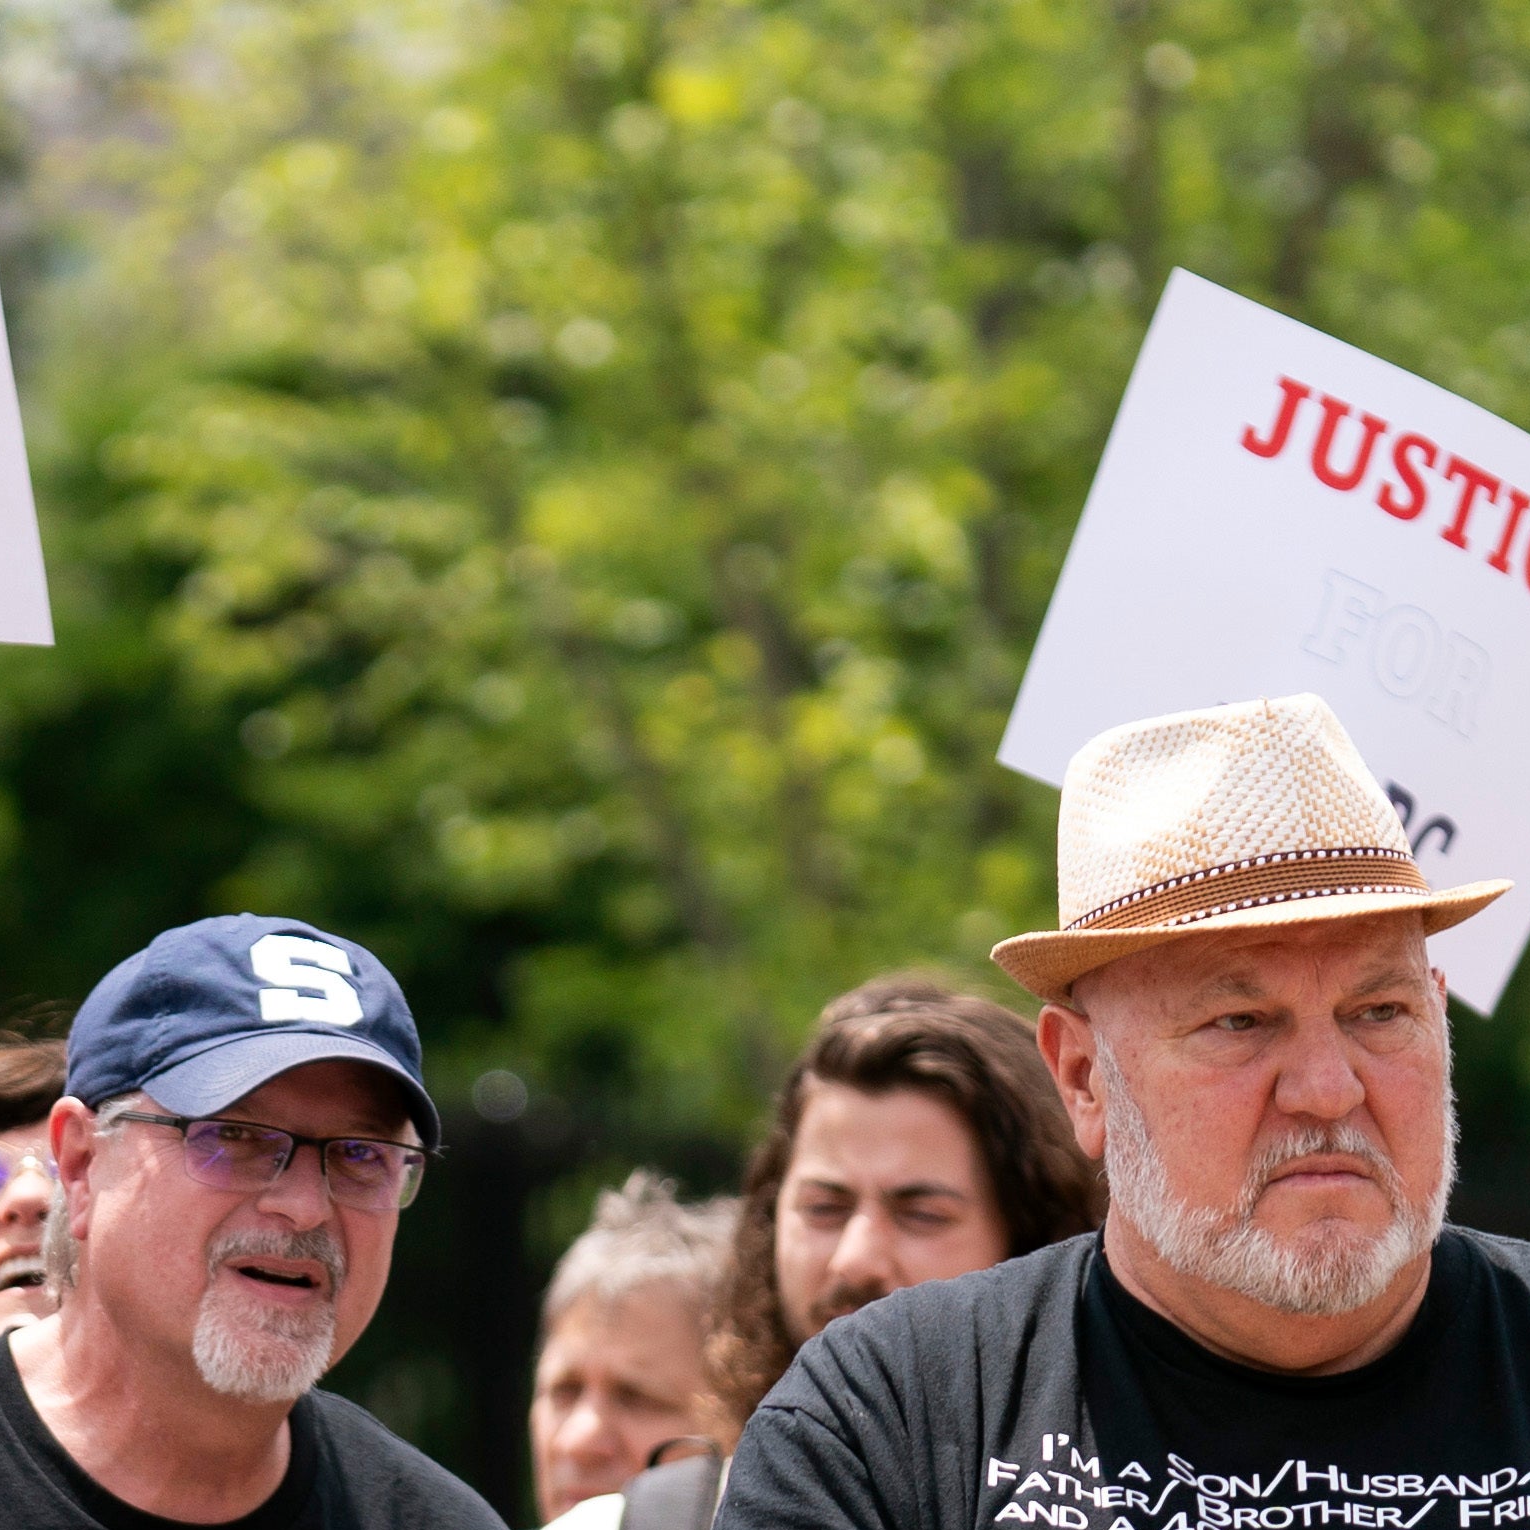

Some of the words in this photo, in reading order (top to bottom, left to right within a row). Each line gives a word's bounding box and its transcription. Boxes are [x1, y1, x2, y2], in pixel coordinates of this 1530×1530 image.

[1299, 566, 1494, 740] FOR
[250, 934, 363, 1026] S
[987, 1457, 1179, 1515] FATHER/
[1043, 1433, 1101, 1478] I'M
[1118, 1461, 1150, 1481] A
[994, 1501, 1088, 1530] AND
